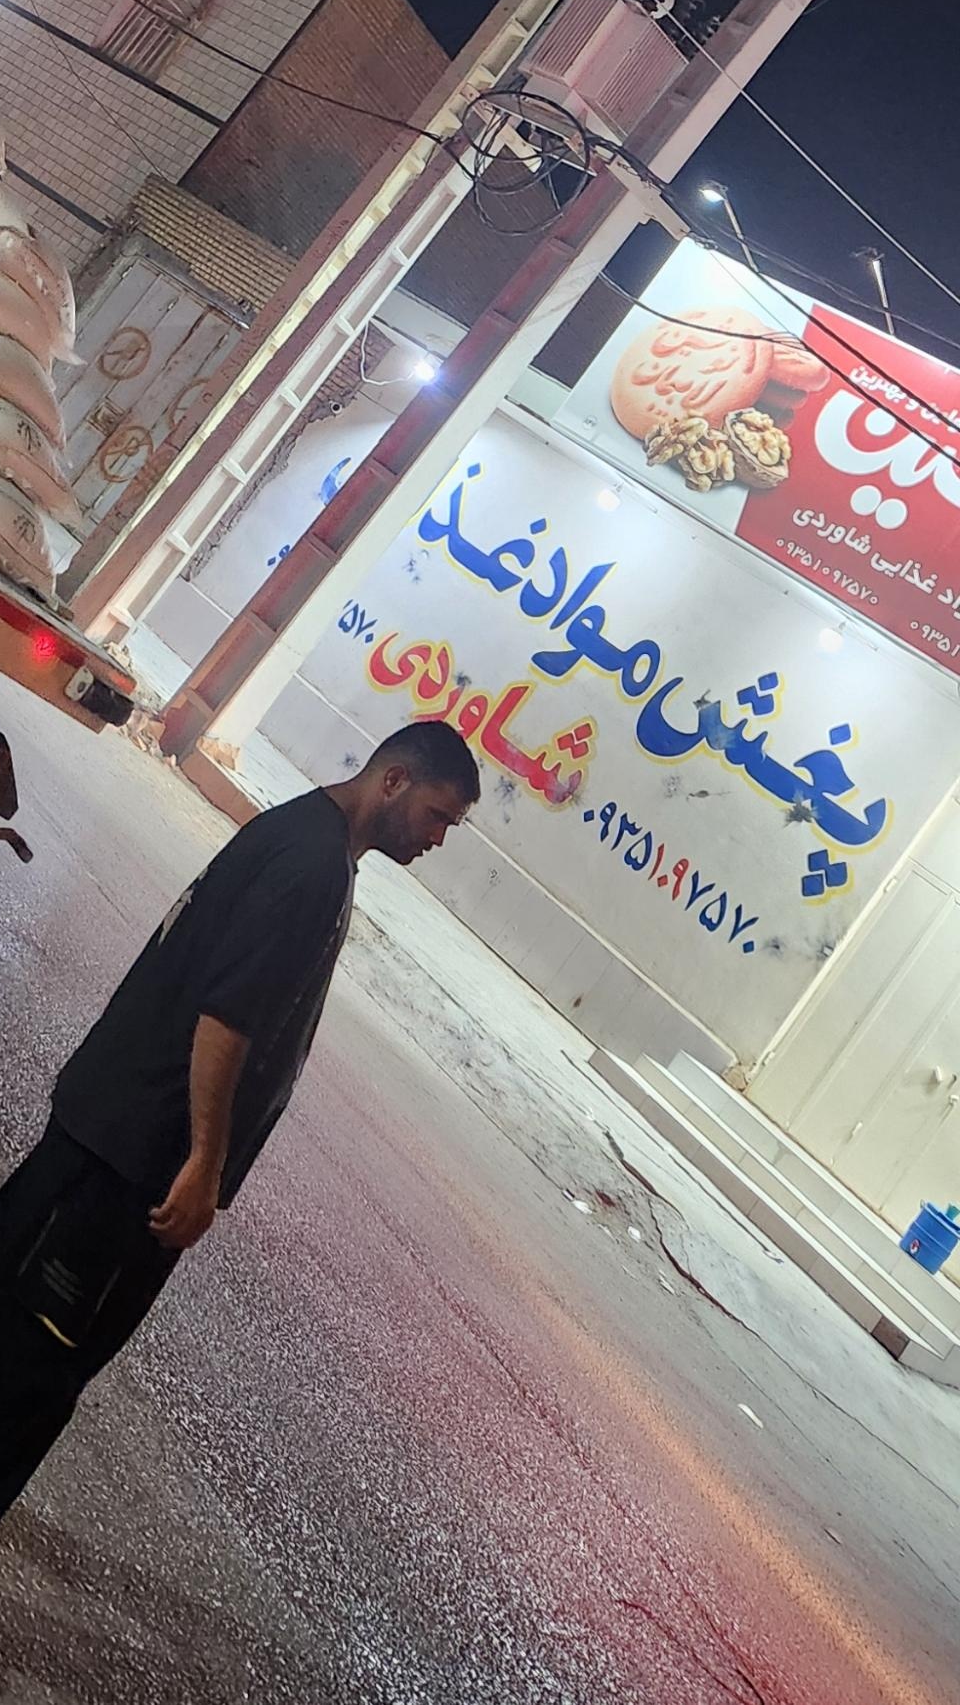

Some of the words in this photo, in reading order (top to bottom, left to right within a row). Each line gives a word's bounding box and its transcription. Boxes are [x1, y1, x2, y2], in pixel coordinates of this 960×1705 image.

[849, 365, 908, 403] بهترین
[792, 508, 872, 555] شاوردی
[776, 538, 878, 605] ۰۹۳۵۱۰۹۷۵۷۰
[870, 552, 938, 595] غذایی
[519, 546, 661, 697] مواد
[909, 620, 960, 657] ۰۹۳۵۱
[636, 671, 887, 897] پخش
[582, 801, 760, 955] ۰۹۳۵۱۰۹۷۵۷۰
